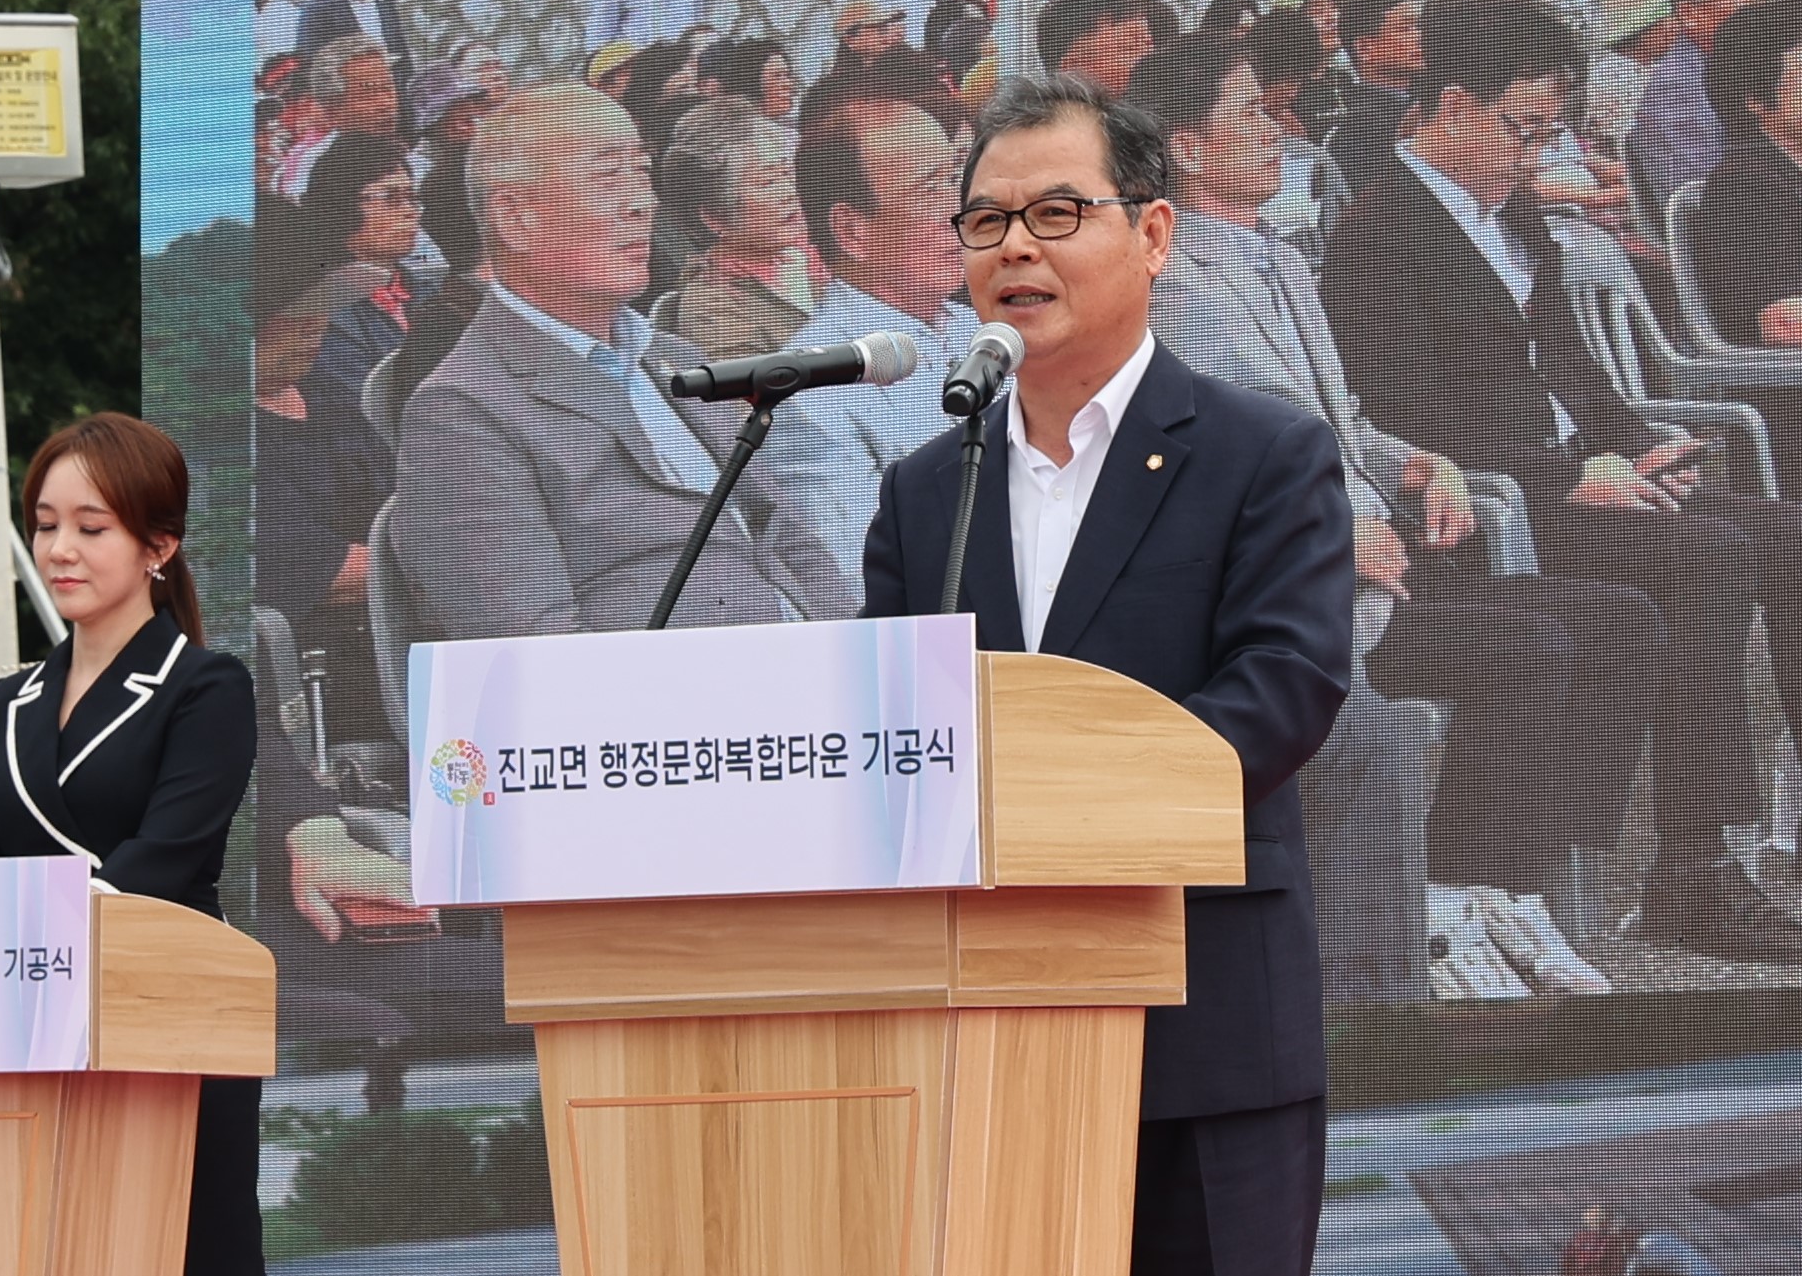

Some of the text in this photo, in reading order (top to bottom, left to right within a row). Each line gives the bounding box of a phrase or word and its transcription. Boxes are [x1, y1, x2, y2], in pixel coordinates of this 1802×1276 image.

[497, 726, 955, 794] 진교면 행정문화복합타운 기공식
[3, 946, 73, 982] 기공식
